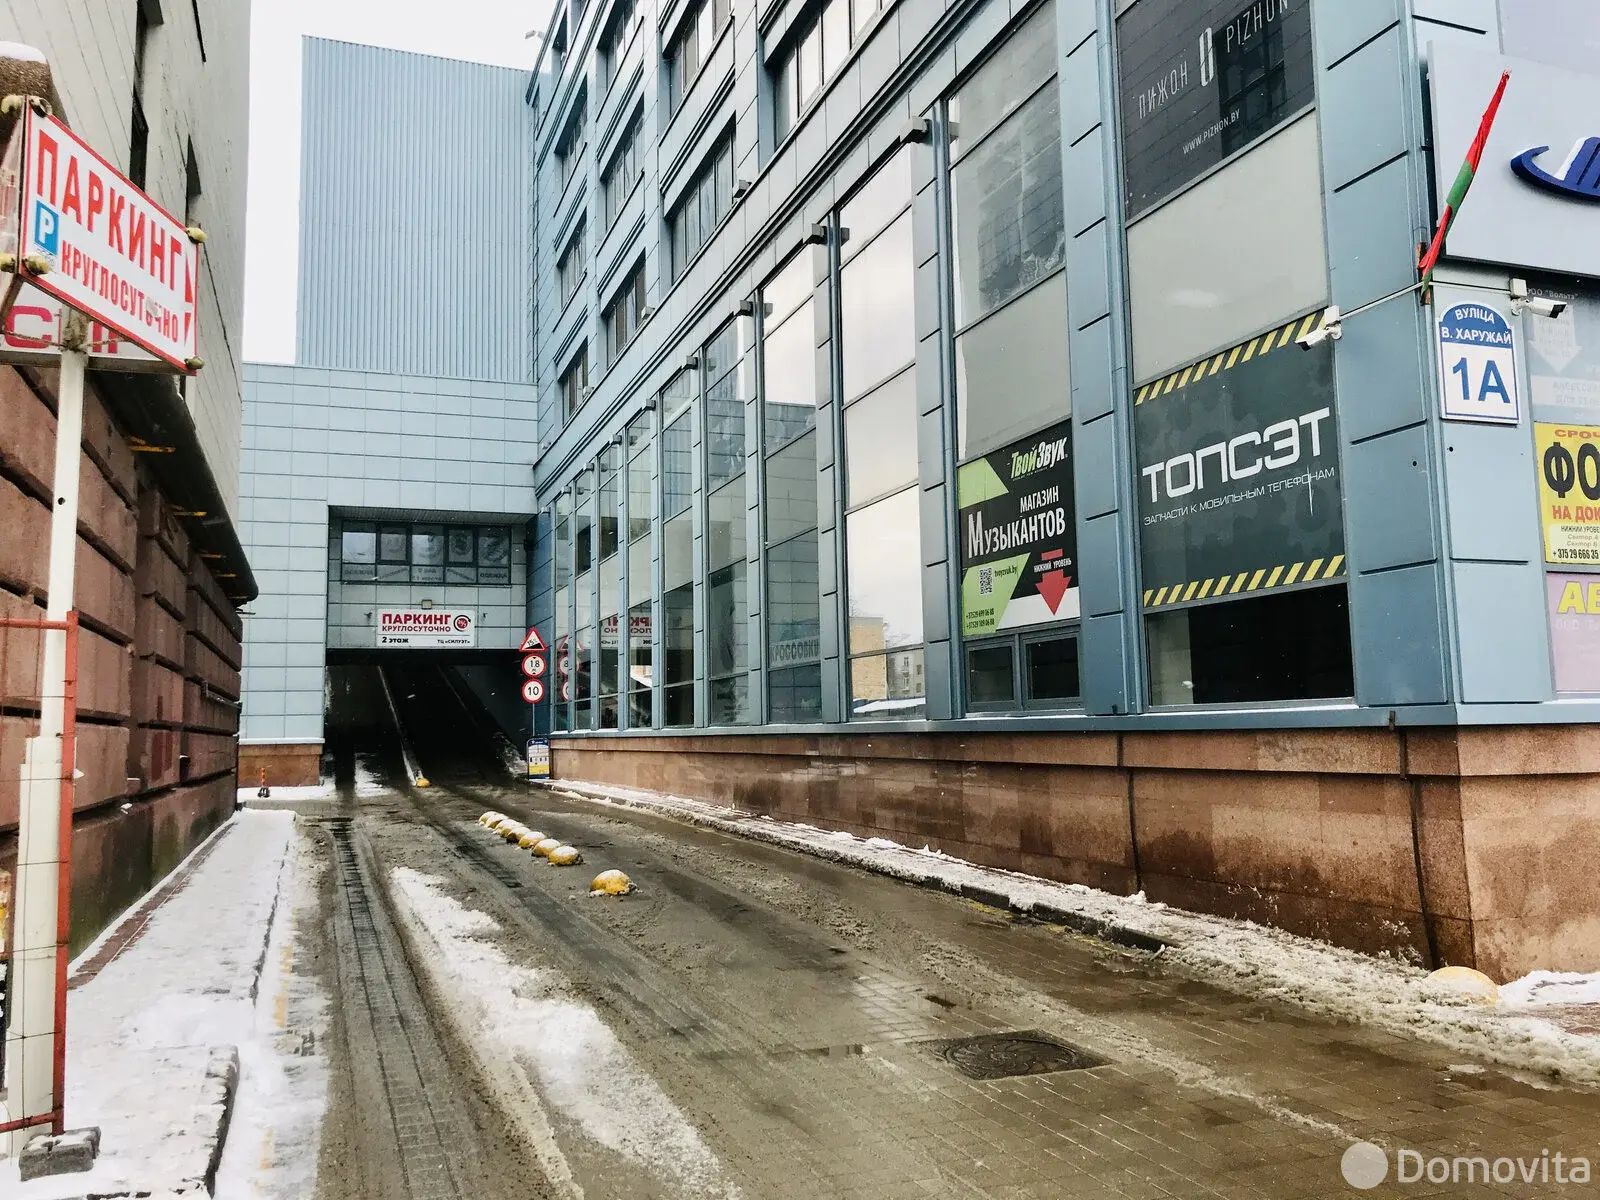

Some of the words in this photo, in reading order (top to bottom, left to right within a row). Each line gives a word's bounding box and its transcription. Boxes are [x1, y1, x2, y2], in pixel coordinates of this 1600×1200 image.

[1138, 60, 1188, 120] ПИЖОН
[1182, 109, 1241, 155] WWW.PIZHON.BY
[1454, 307, 1495, 324] ВУЛІЦА
[1441, 326, 1453, 339] В.
[1455, 327, 1512, 345] ХАРУЖАЙ
[1452, 357, 1511, 404] 1А
[1142, 406, 1330, 503] ТОПСЭТ
[1020, 485, 1059, 514] МАГАЗИН
[1143, 505, 1189, 526] ЗАПЧАСТИ
[1190, 503, 1198, 513] К
[1199, 485, 1265, 512] МОБИЛЬНЫМ
[1267, 467, 1336, 493] ТЕЛЕФОНАМ
[1552, 505, 1571, 520] НА
[381, 613, 452, 625] ПАРКИНГ
[381, 625, 452, 633] КРУГЛОСУТОЧНО
[527, 686, 540, 696] 10
